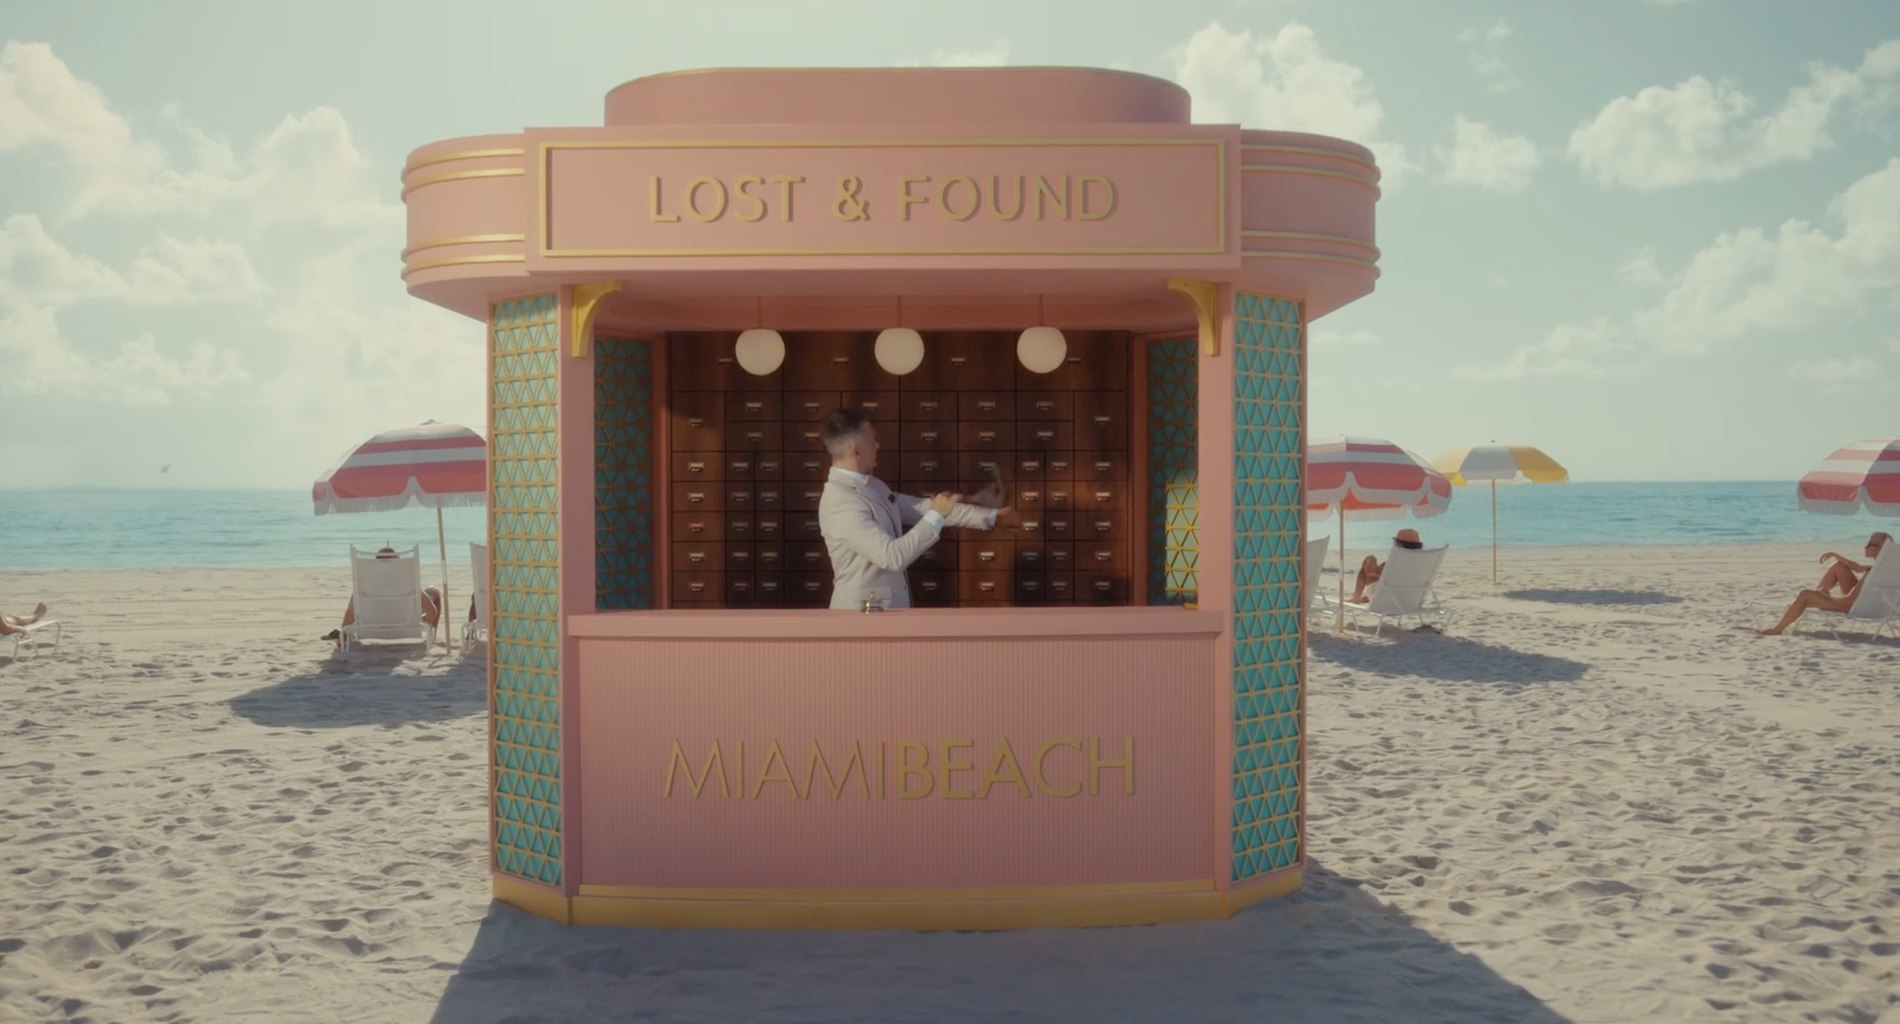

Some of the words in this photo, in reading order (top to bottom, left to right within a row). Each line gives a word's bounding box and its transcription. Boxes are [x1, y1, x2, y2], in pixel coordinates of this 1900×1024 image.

[650, 176, 805, 223] LOST
[832, 174, 870, 222] &
[902, 174, 1118, 223] FOUND
